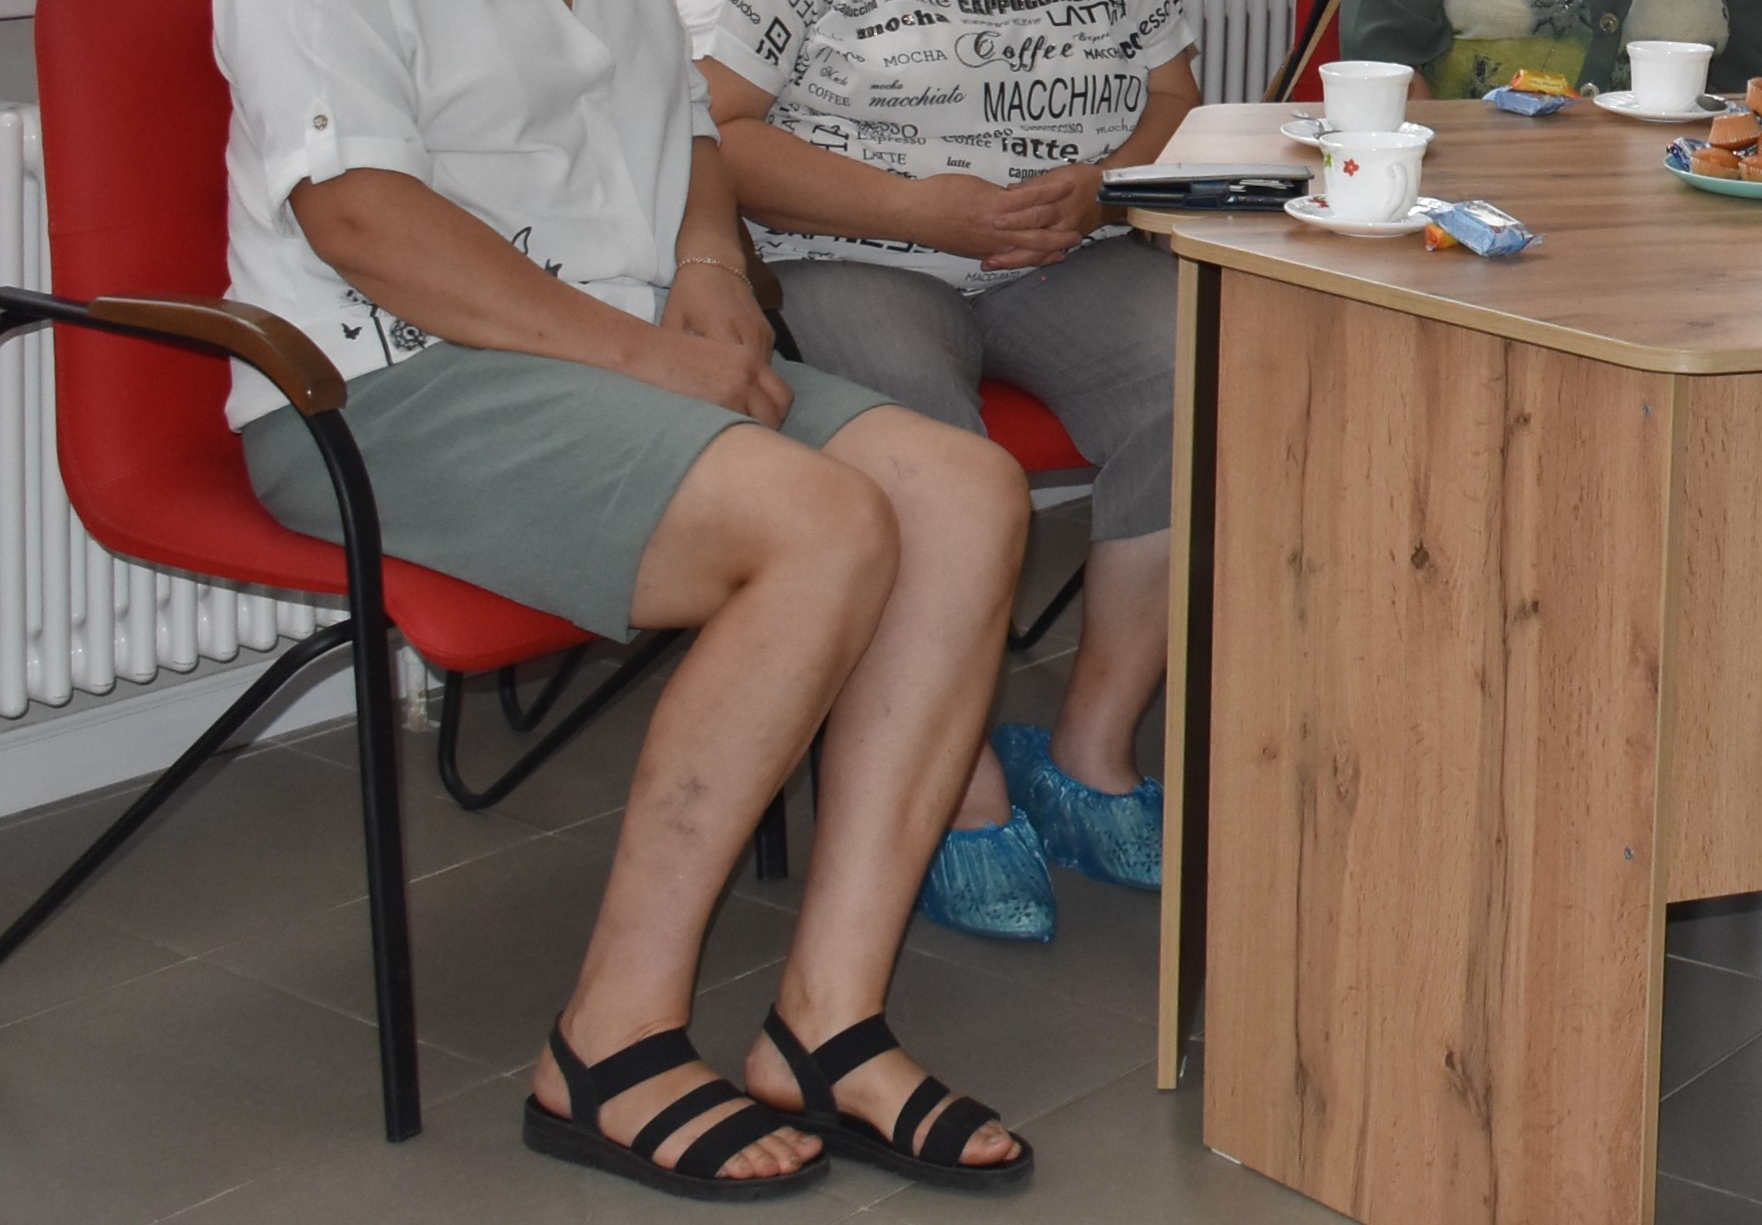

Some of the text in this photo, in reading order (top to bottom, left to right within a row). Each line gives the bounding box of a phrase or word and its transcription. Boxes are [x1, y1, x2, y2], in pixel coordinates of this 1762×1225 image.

[856, 9, 951, 39] mocha
[883, 49, 948, 68] MOCHA
[954, 31, 1072, 72] Coffee
[808, 82, 851, 108] COFFEE
[868, 84, 966, 108] macchiato
[983, 74, 1142, 123] MACCHIATO
[946, 156, 971, 168] latte
